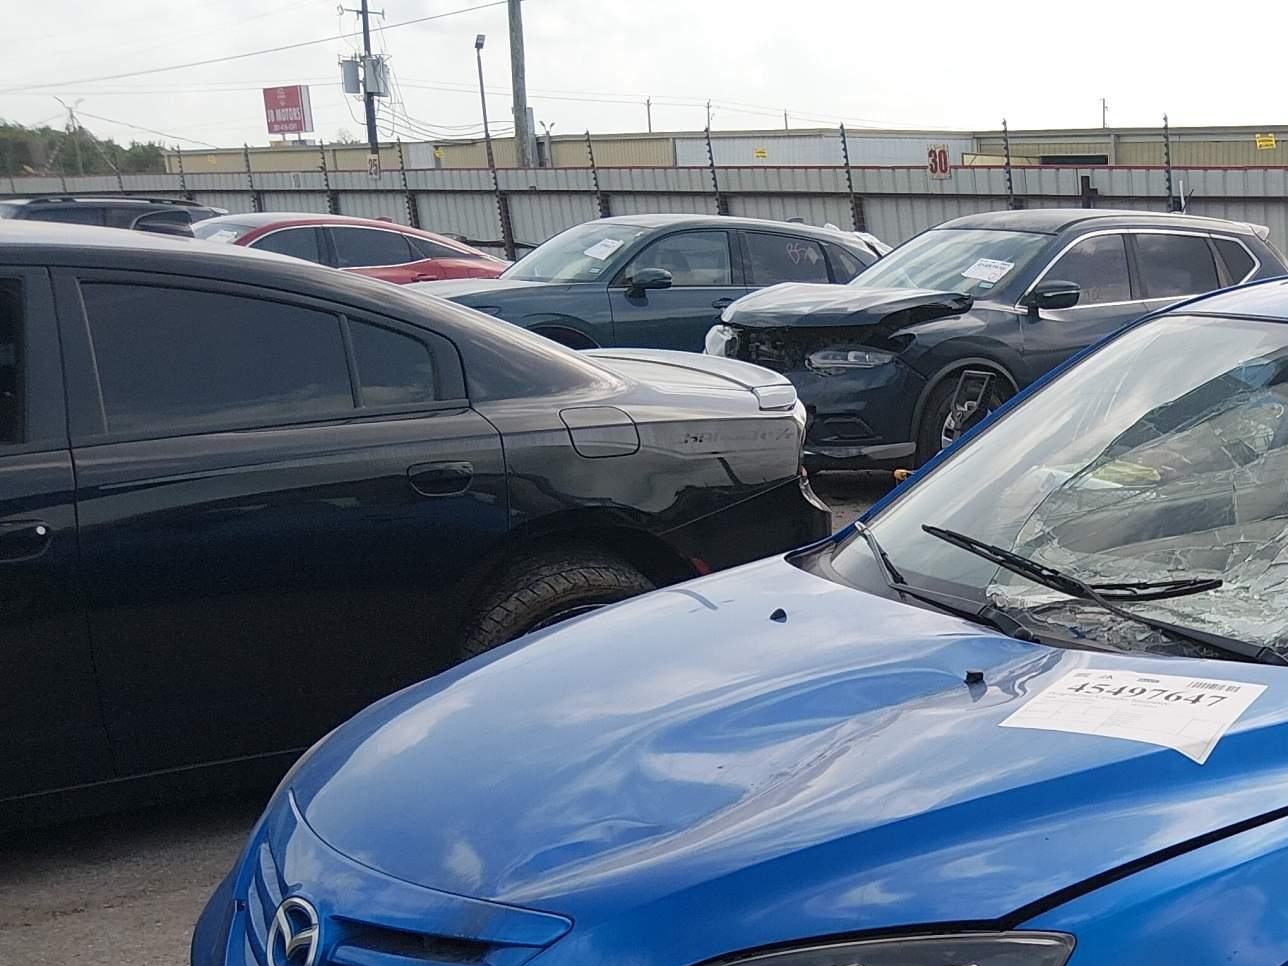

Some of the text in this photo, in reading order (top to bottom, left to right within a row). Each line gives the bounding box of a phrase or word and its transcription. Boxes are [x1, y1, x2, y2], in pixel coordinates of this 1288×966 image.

[276, 106, 302, 122] MOTORS
[368, 158, 379, 176] 25
[928, 149, 948, 174] 30
[1066, 681, 1228, 707] 45497647
